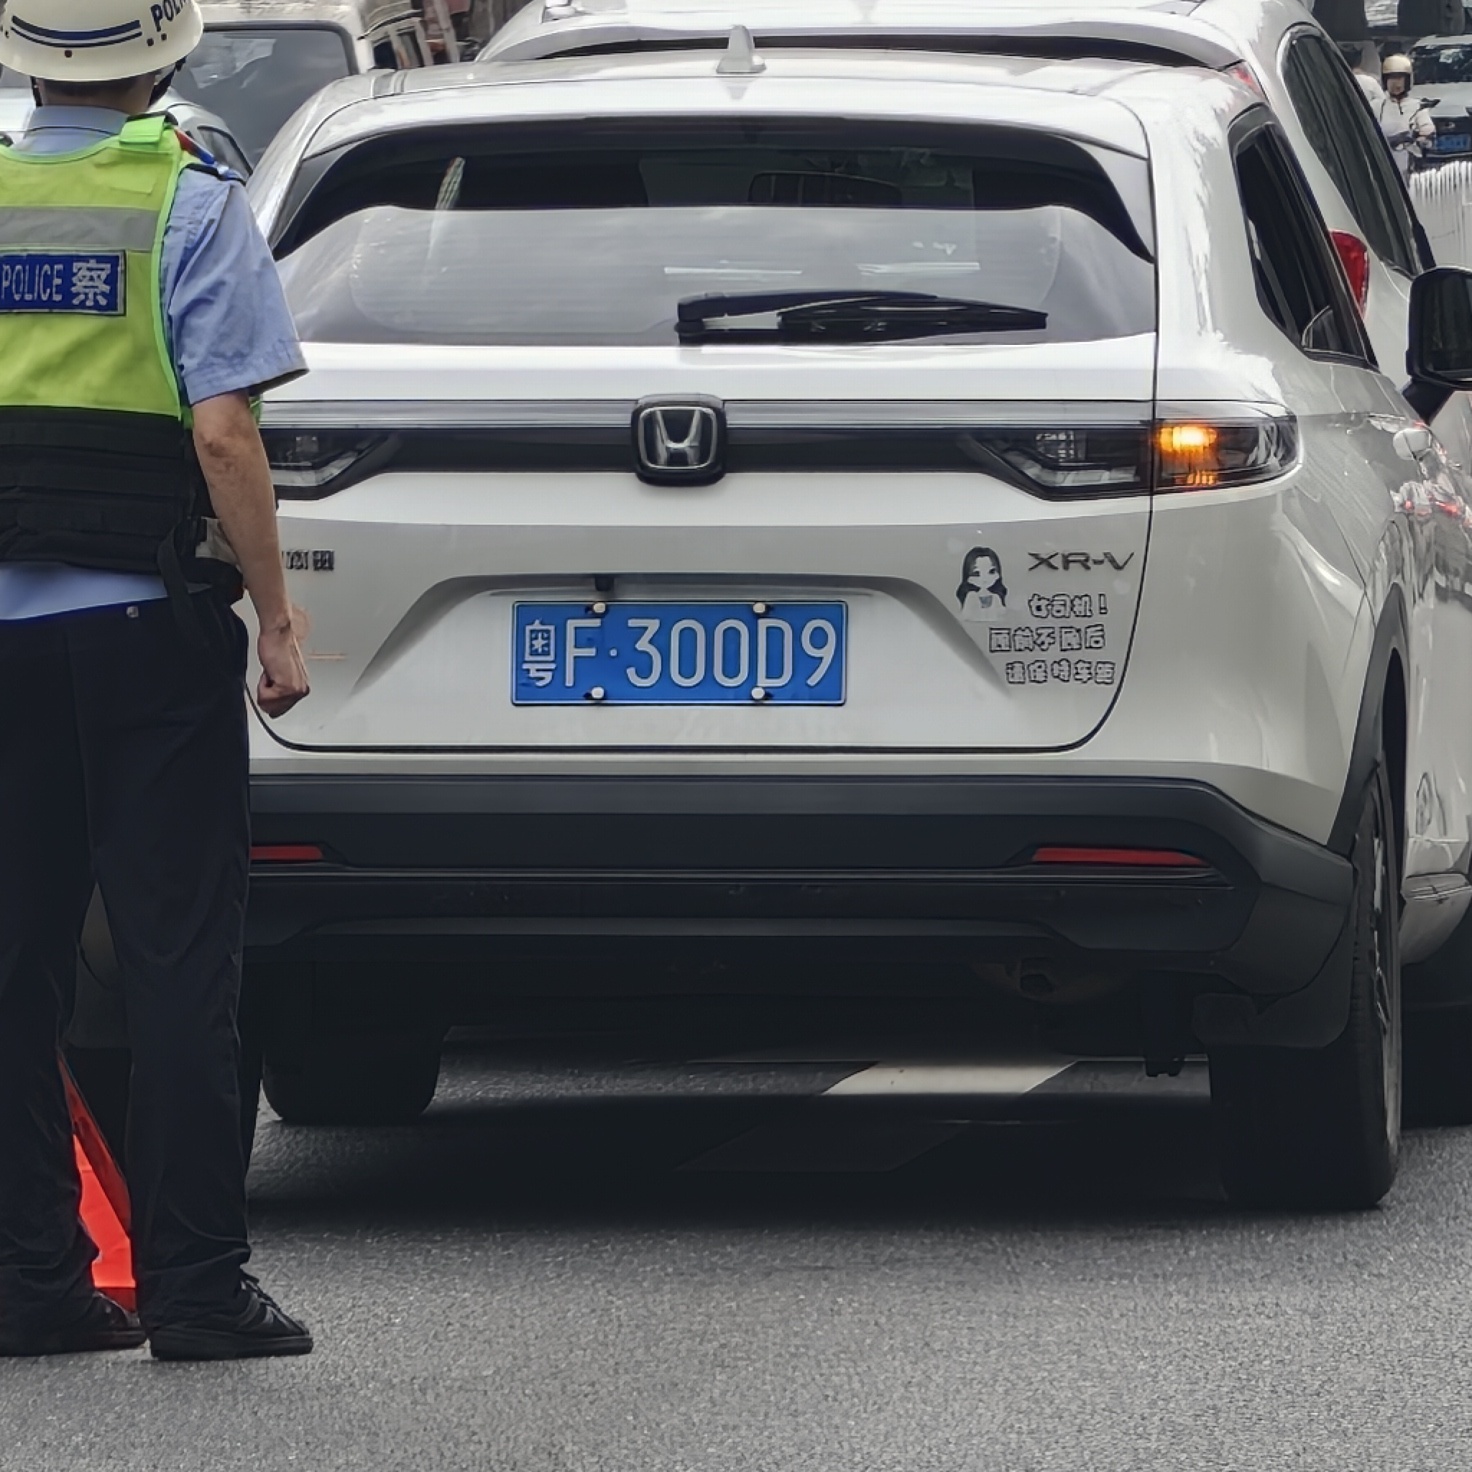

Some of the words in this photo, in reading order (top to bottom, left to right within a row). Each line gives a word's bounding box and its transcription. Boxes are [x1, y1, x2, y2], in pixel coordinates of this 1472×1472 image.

[1, 263, 64, 302] POLICE
[71, 259, 112, 307] 察
[1027, 551, 1135, 572] XR-V
